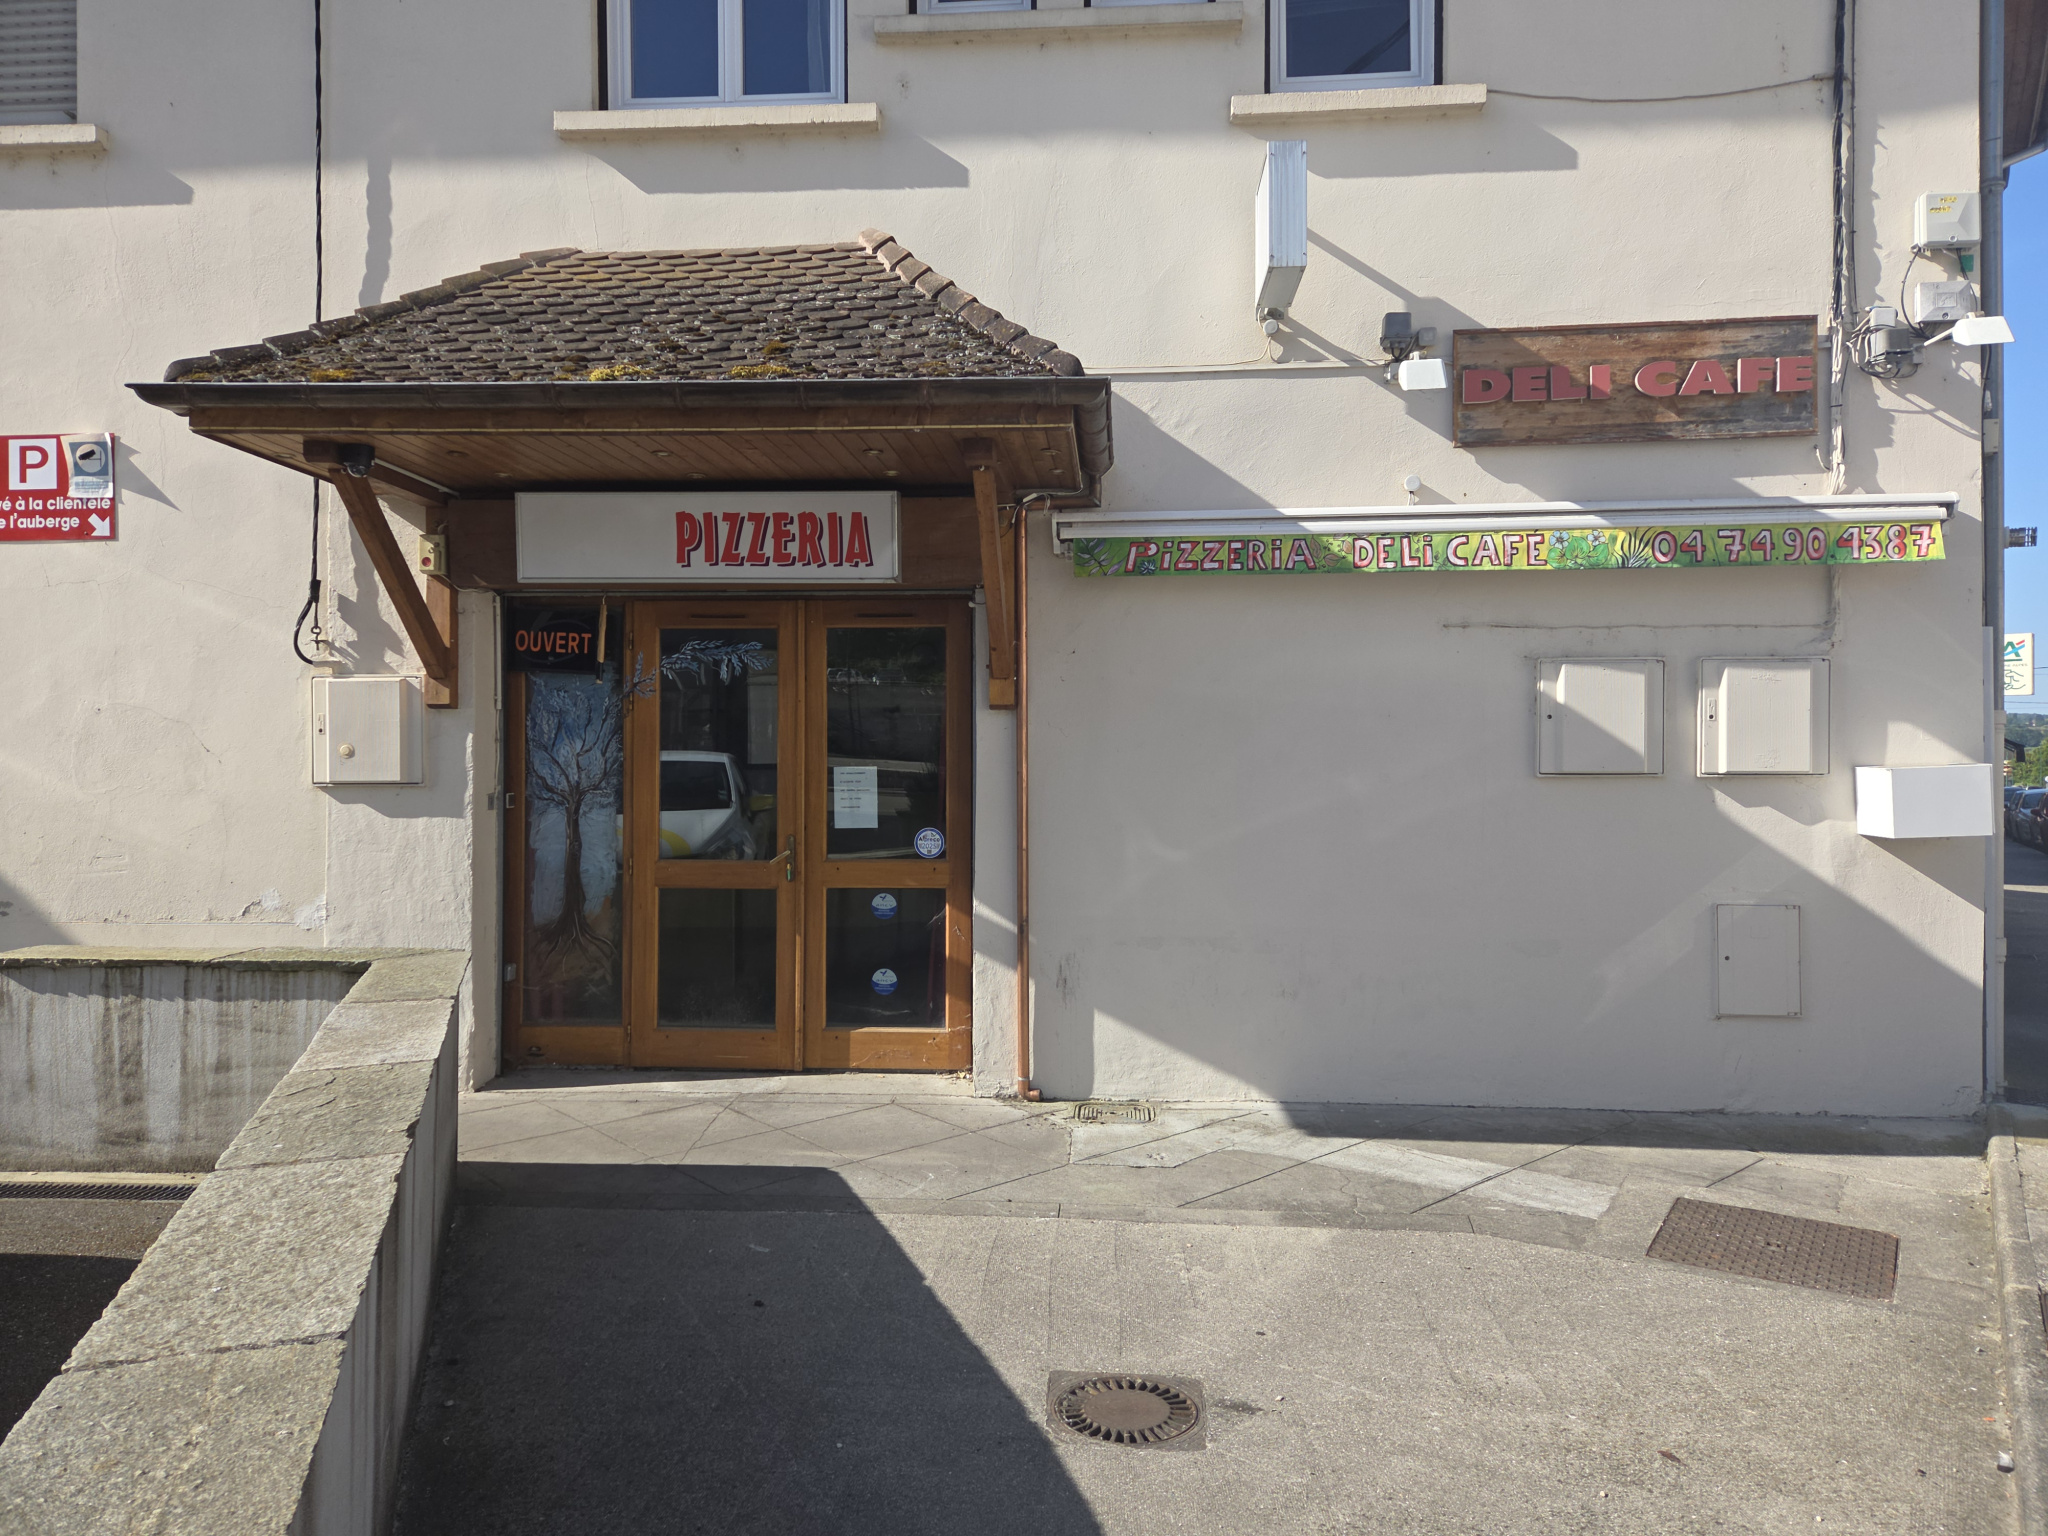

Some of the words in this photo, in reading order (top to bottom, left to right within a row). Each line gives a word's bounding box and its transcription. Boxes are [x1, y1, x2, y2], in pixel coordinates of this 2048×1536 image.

[1462, 364, 1612, 404] DELI
[1634, 355, 1813, 397] CAFE
[19, 445, 49, 484] P
[15, 496, 25, 511] à
[28, 496, 43, 511] la
[9, 513, 80, 531] l'auberge
[675, 510, 874, 569] PIZZERIA
[515, 630, 592, 654] OUVERT
